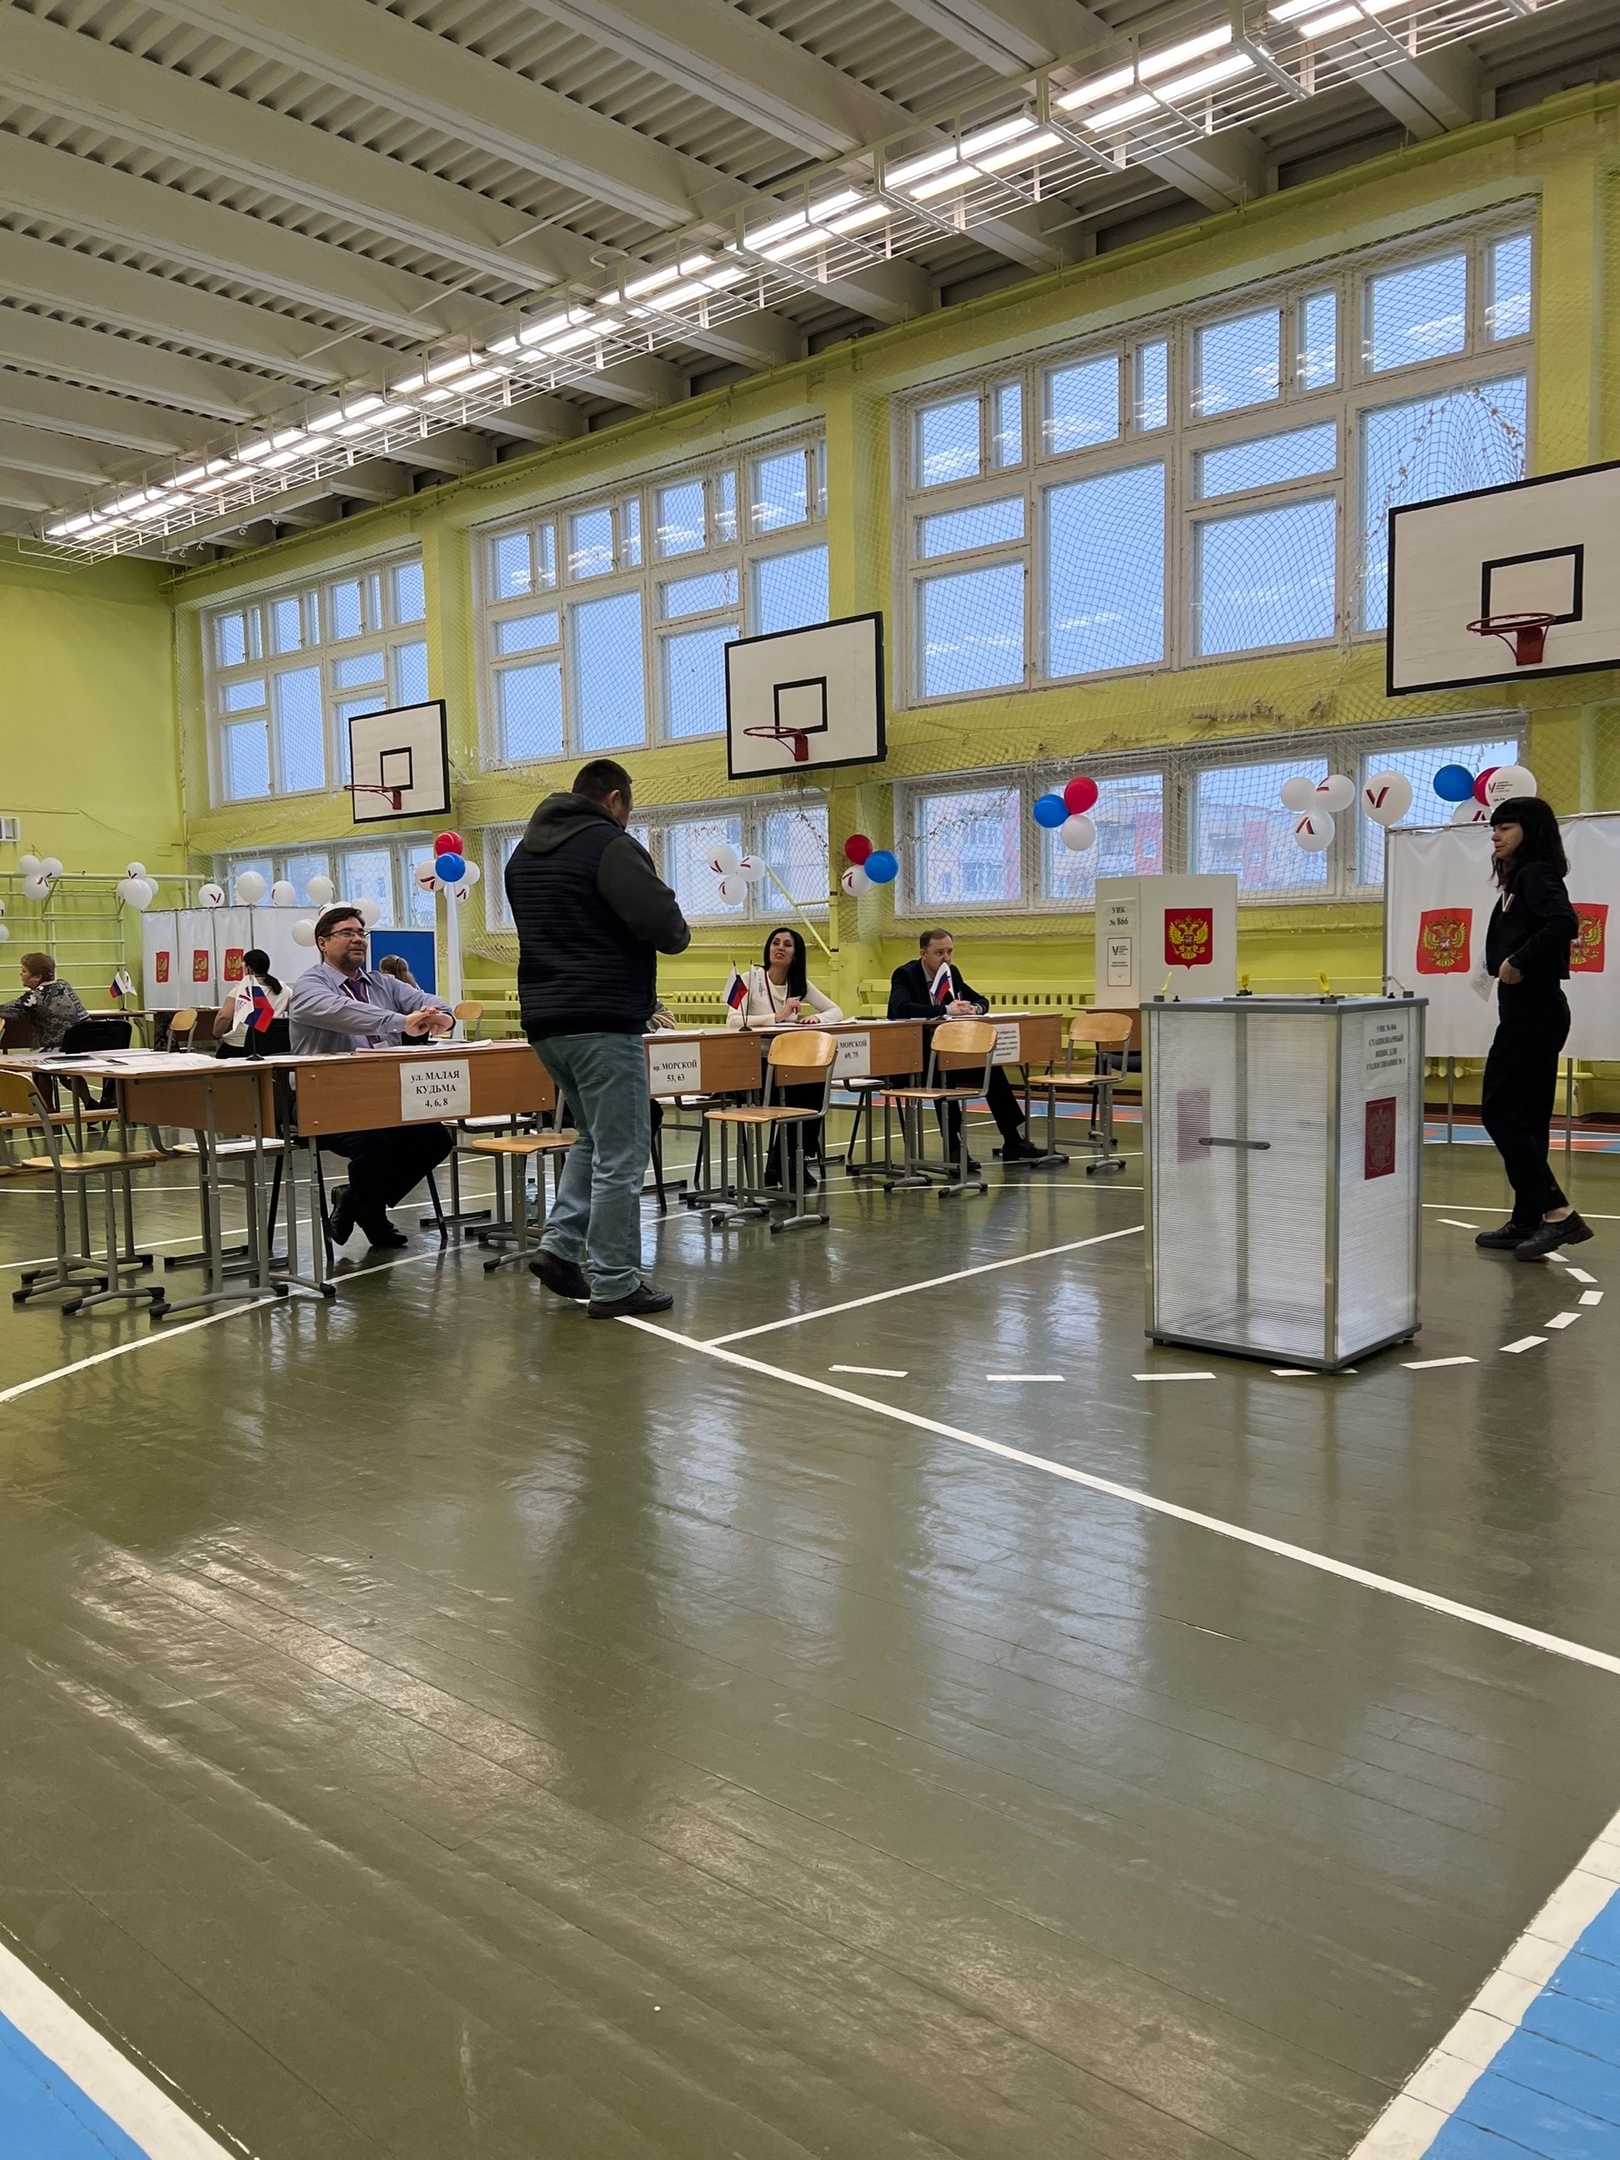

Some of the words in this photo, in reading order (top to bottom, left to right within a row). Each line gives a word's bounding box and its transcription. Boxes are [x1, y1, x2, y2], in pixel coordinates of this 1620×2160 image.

[1111, 906, 1126, 914] УИК
[1117, 917, 1129, 925] 866
[840, 1039, 867, 1049] МОРСКОЙ
[662, 1059, 698, 1070] МОРСКОЙ
[411, 1074, 423, 1083] ул.
[425, 1070, 460, 1081] МАЛАЯ
[667, 1074, 676, 1082] 53,
[677, 1073, 685, 1081] 63
[416, 1084, 456, 1095] КУДЬМА
[425, 1099, 433, 1108] 4,
[434, 1098, 441, 1107] 6,
[443, 1097, 449, 1106] 8
